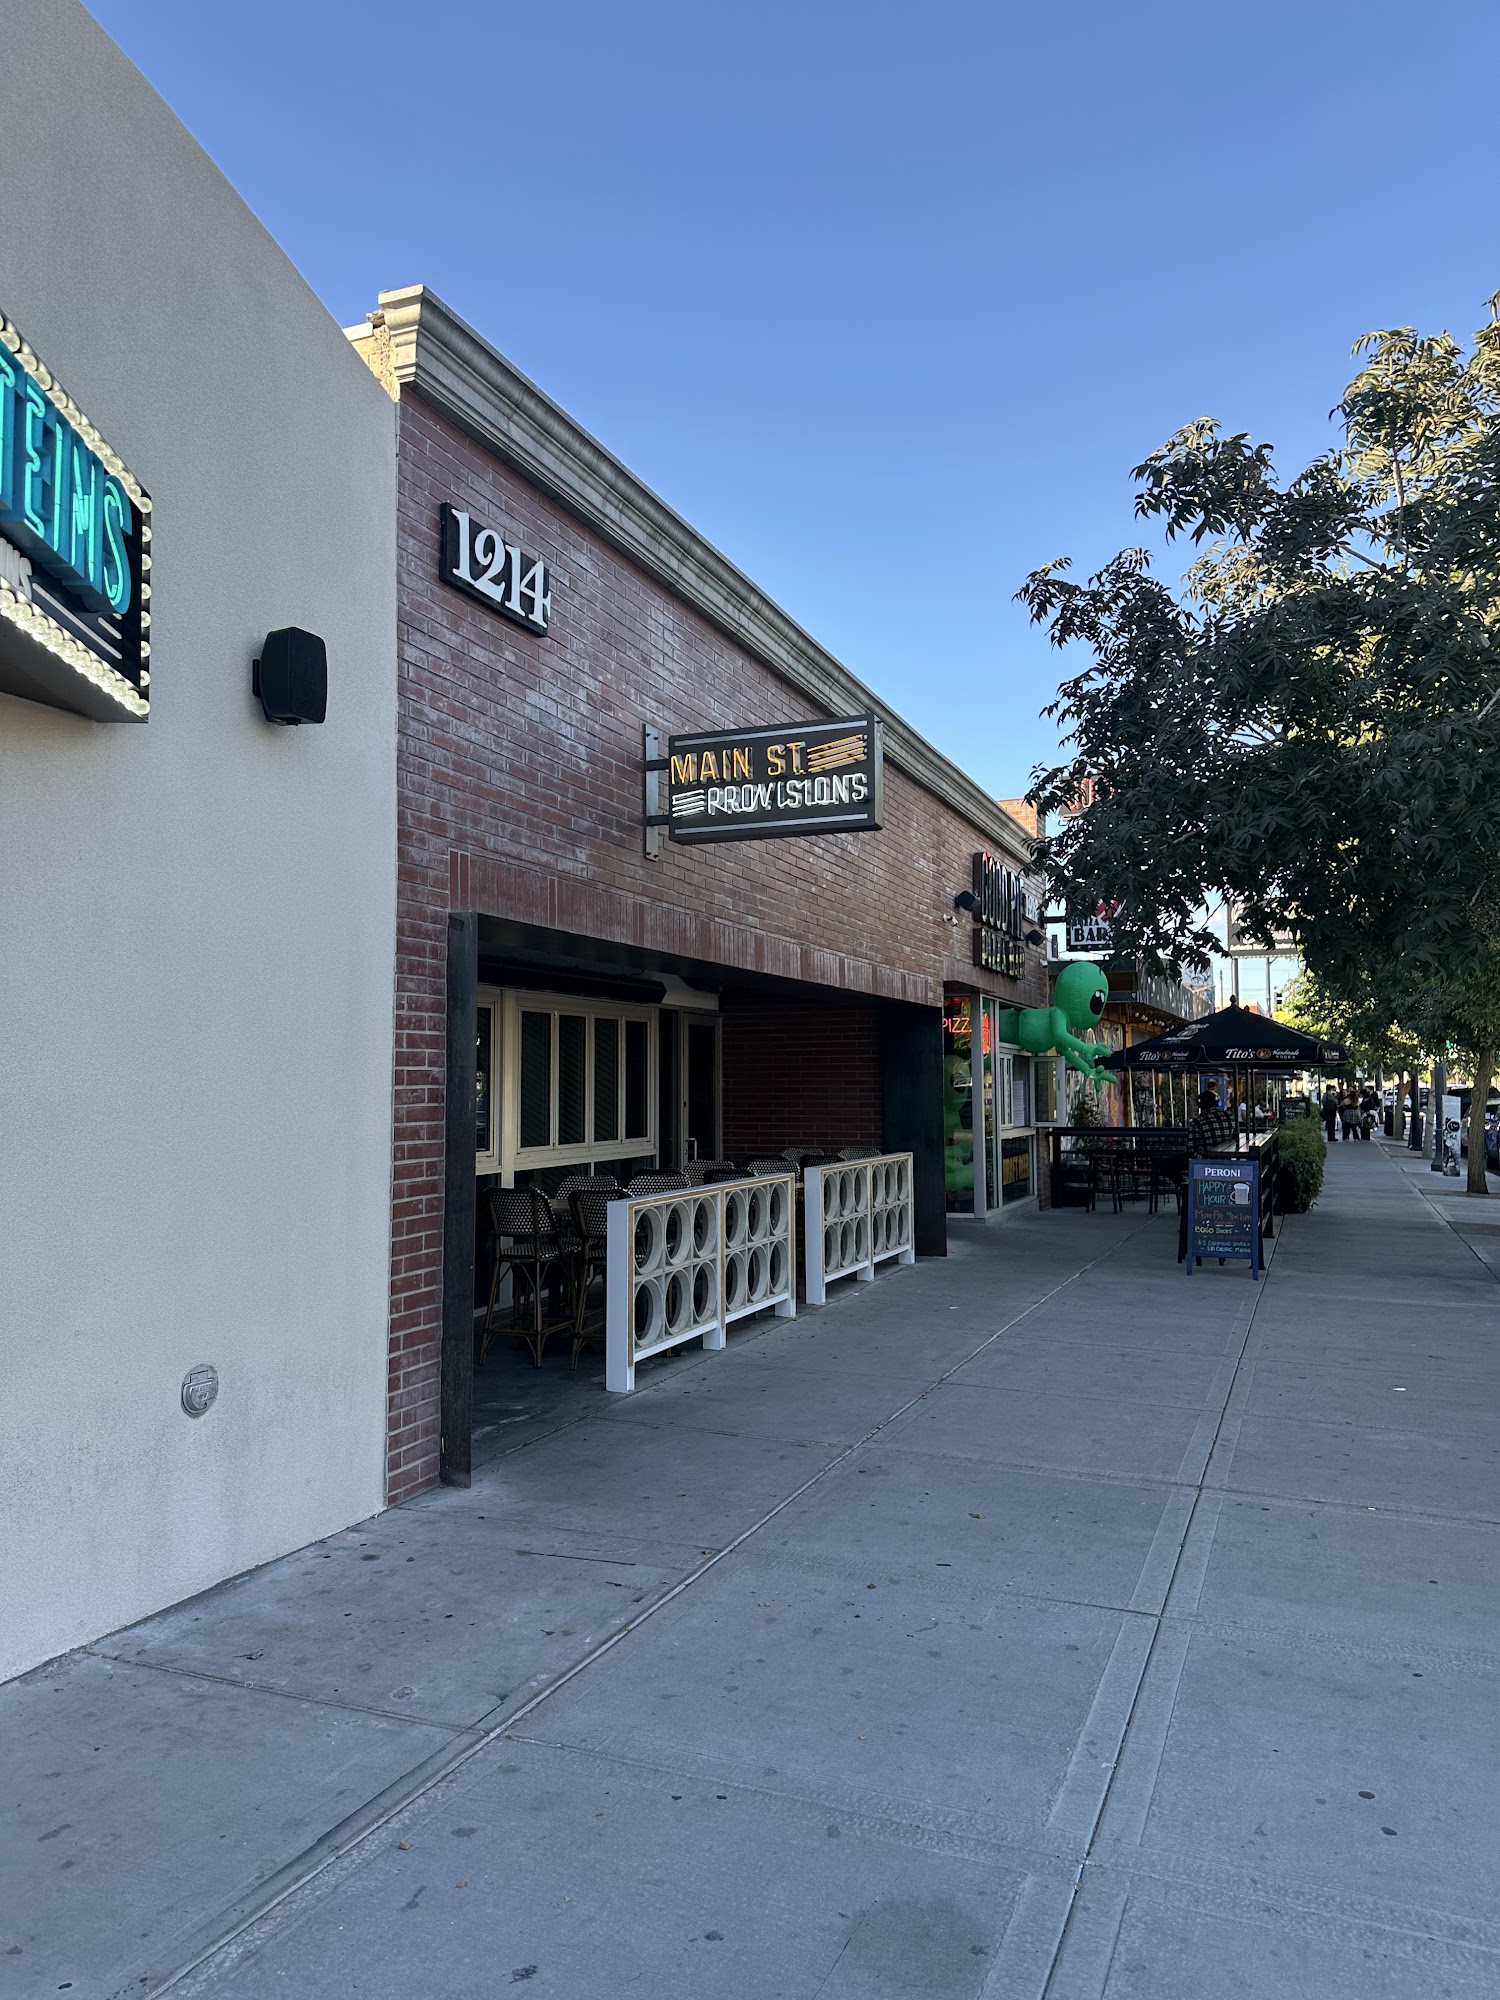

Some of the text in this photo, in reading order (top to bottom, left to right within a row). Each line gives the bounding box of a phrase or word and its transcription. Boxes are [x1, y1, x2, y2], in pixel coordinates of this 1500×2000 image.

[451, 509, 551, 628] 1214
[671, 747, 753, 786] MAIN
[708, 773, 868, 815] PROVISIONS
[943, 1018, 972, 1032] PIZZ
[1139, 1050, 1161, 1061] Tito's
[1225, 1048, 1255, 1059] Tito's
[1204, 1167, 1241, 1177] PERONI
[1199, 1181, 1226, 1194] HAPPY
[1204, 1195, 1226, 1205] HOUR
